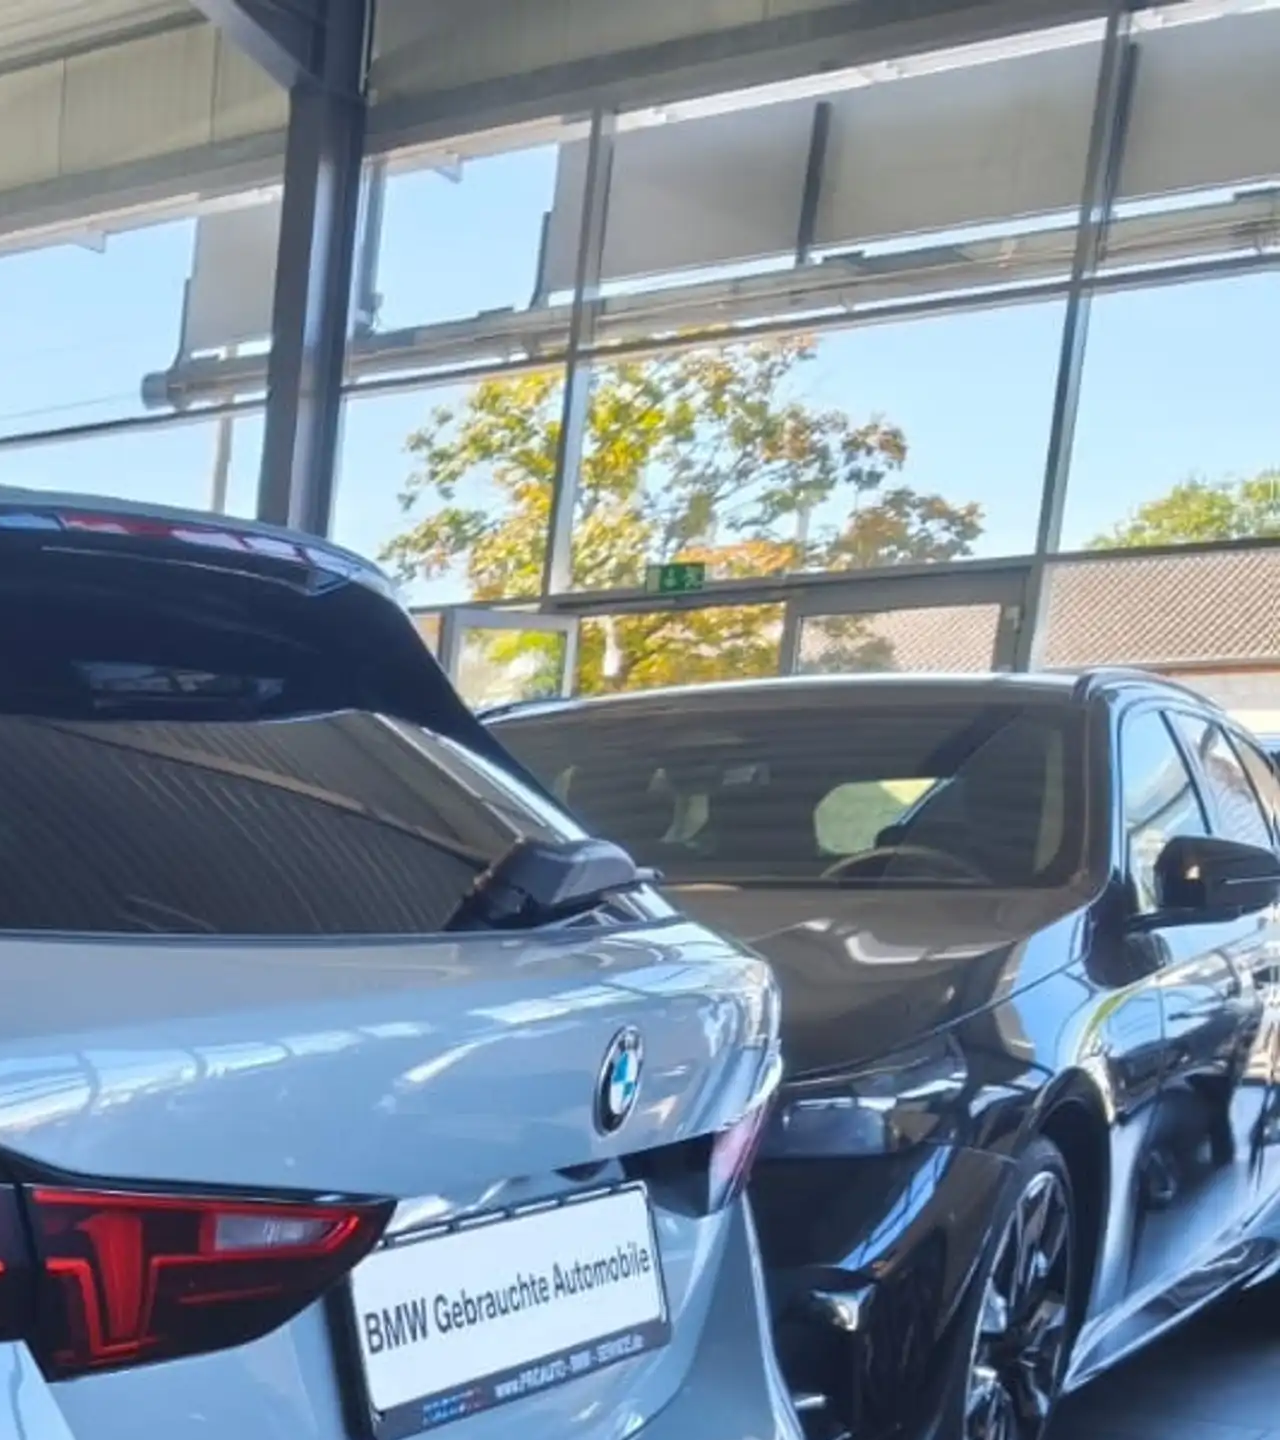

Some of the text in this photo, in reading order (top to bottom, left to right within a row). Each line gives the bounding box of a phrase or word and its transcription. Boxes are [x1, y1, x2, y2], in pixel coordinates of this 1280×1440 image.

[365, 1241, 650, 1354] BMW Gebrauchte Automobile
